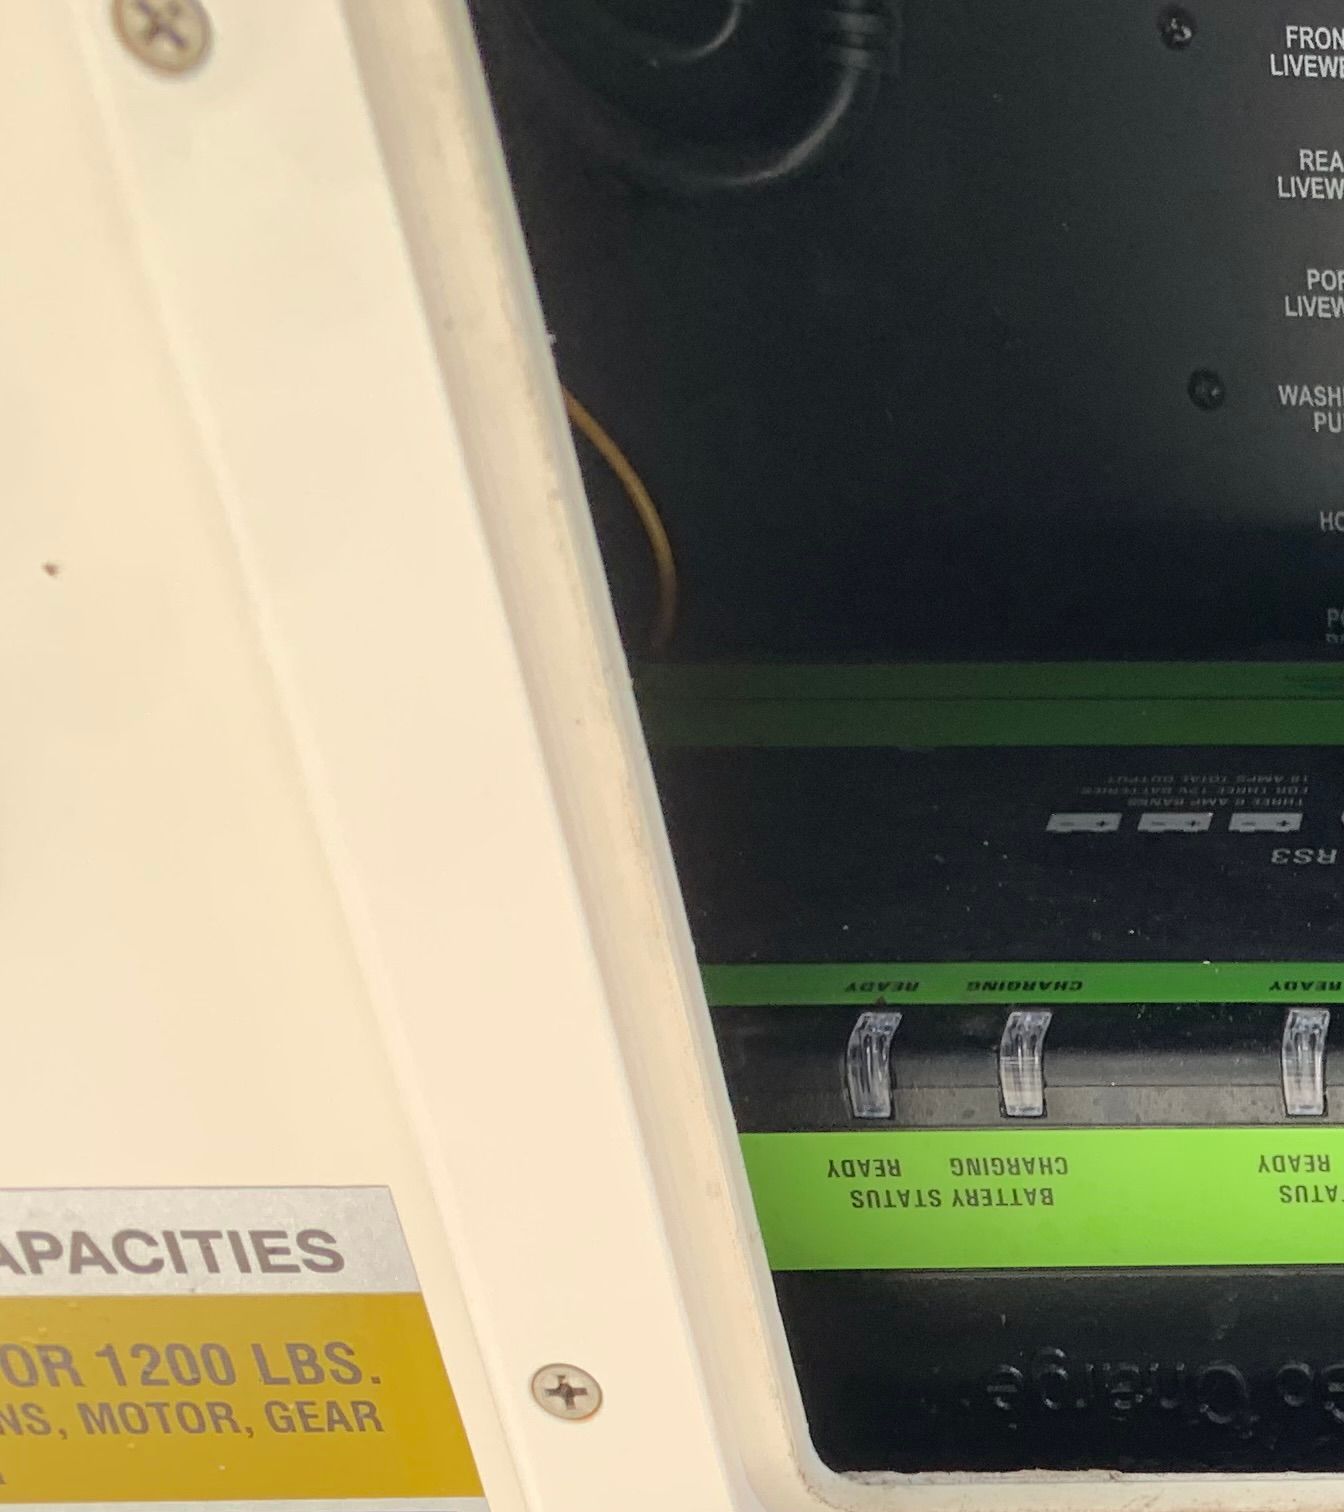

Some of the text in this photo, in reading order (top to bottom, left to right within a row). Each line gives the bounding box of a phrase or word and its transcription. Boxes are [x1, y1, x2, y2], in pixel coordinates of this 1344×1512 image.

[1271, 848, 1338, 865] RS3
[844, 980, 1083, 993] CHARGING READY
[1269, 980, 1342, 991] READY
[827, 1156, 1068, 1179] CHARGING READY
[1258, 1154, 1331, 1174] READY
[849, 1187, 1054, 1209] BATTERY STATUS
[95, 1343, 237, 1387] 1200
[251, 1341, 382, 1386] LBS.
[77, 1401, 255, 1439] MOTOR,
[264, 1400, 385, 1433] GEAR
